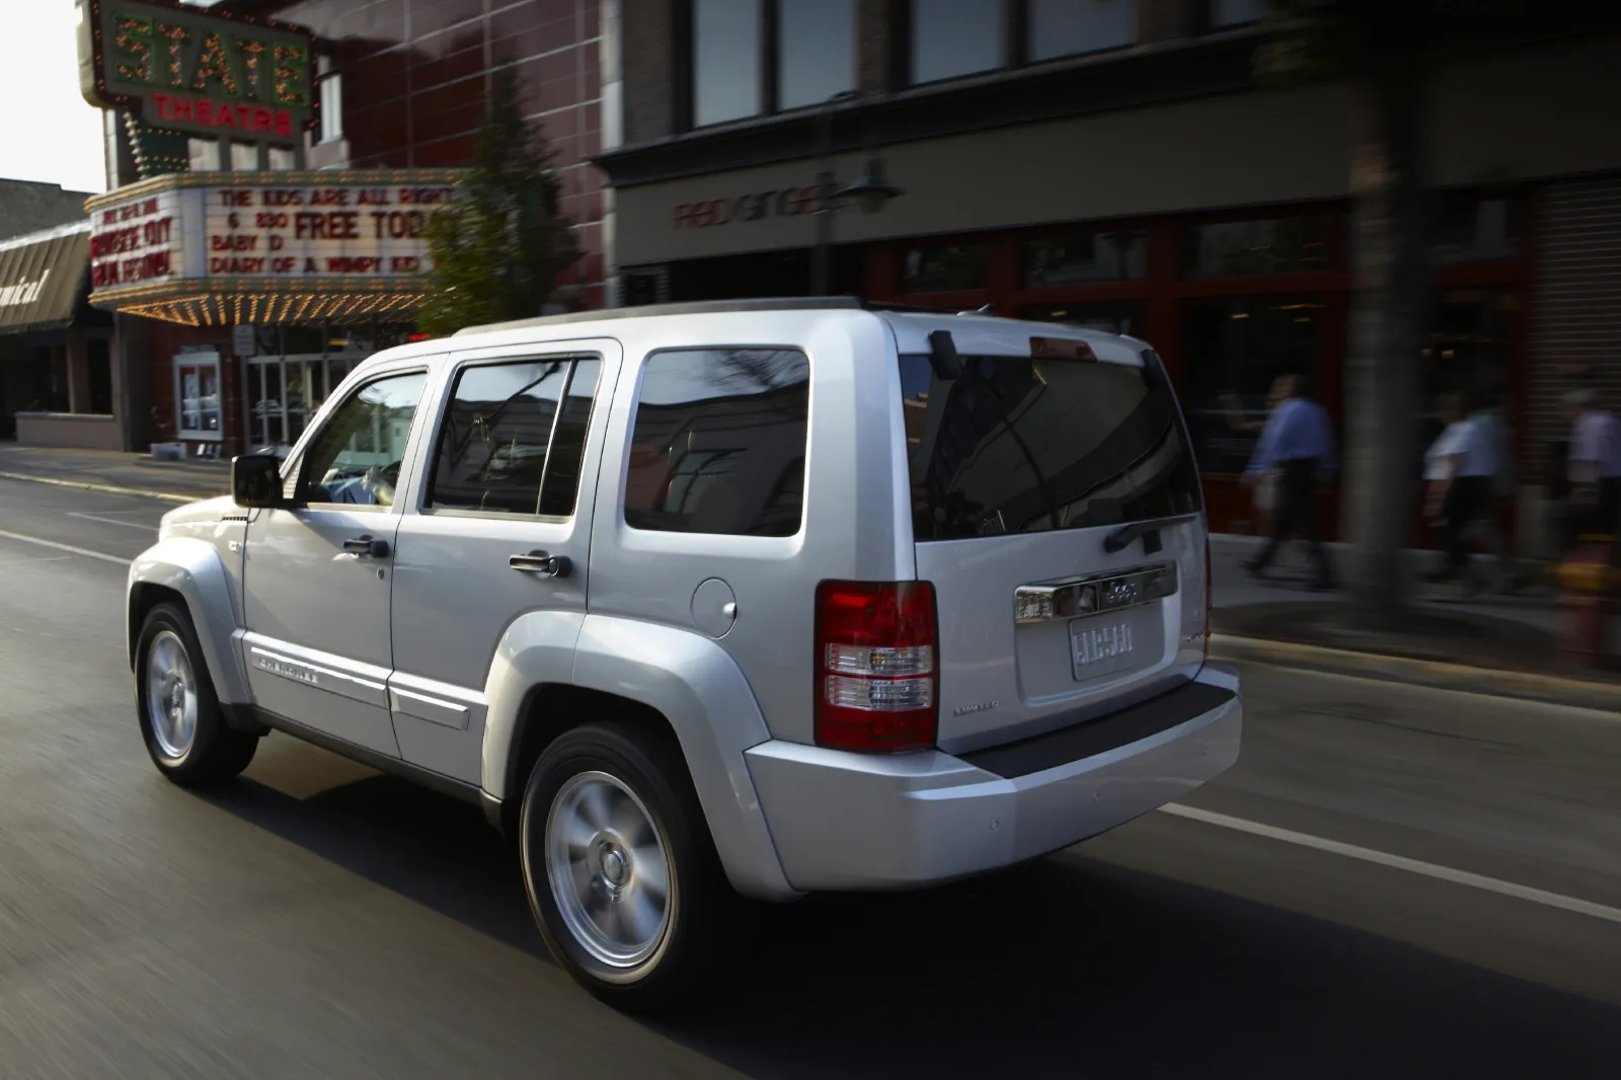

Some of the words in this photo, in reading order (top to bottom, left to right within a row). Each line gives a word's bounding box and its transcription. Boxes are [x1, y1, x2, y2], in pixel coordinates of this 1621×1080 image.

[112, 11, 309, 107] STATE
[151, 92, 294, 138] THEATRE
[219, 188, 253, 207] THE
[310, 187, 349, 206] ARE
[356, 187, 390, 205] ALL
[294, 210, 360, 240] FREE
[371, 209, 428, 239] TOD
[210, 235, 258, 252] BABY
[209, 257, 267, 274] DIARY
[271, 257, 297, 274] OF
[303, 257, 318, 273] A
[0, 268, 50, 307] mical
